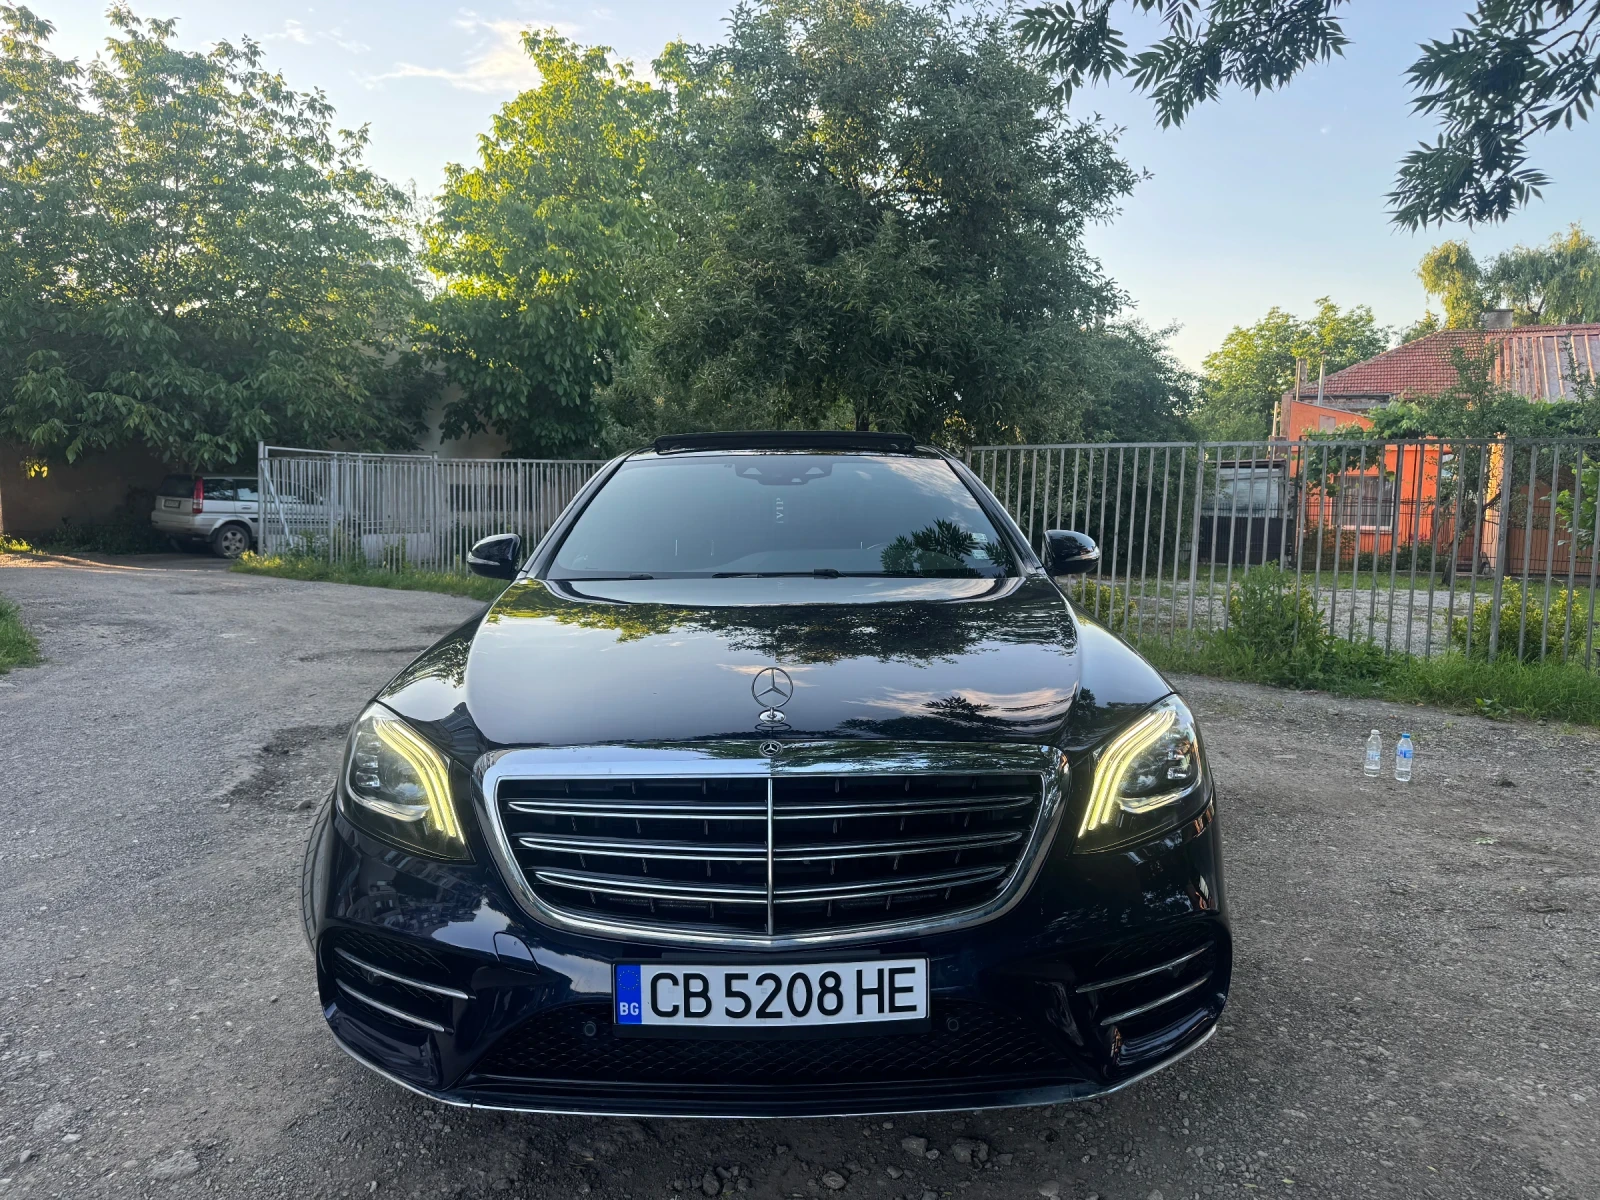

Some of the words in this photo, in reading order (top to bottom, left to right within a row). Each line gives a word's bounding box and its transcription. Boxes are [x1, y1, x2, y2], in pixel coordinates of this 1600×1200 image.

[619, 1002, 639, 1016] BG
[650, 972, 712, 1018] CB
[724, 970, 844, 1019] 5208
[855, 966, 918, 1015] HE
